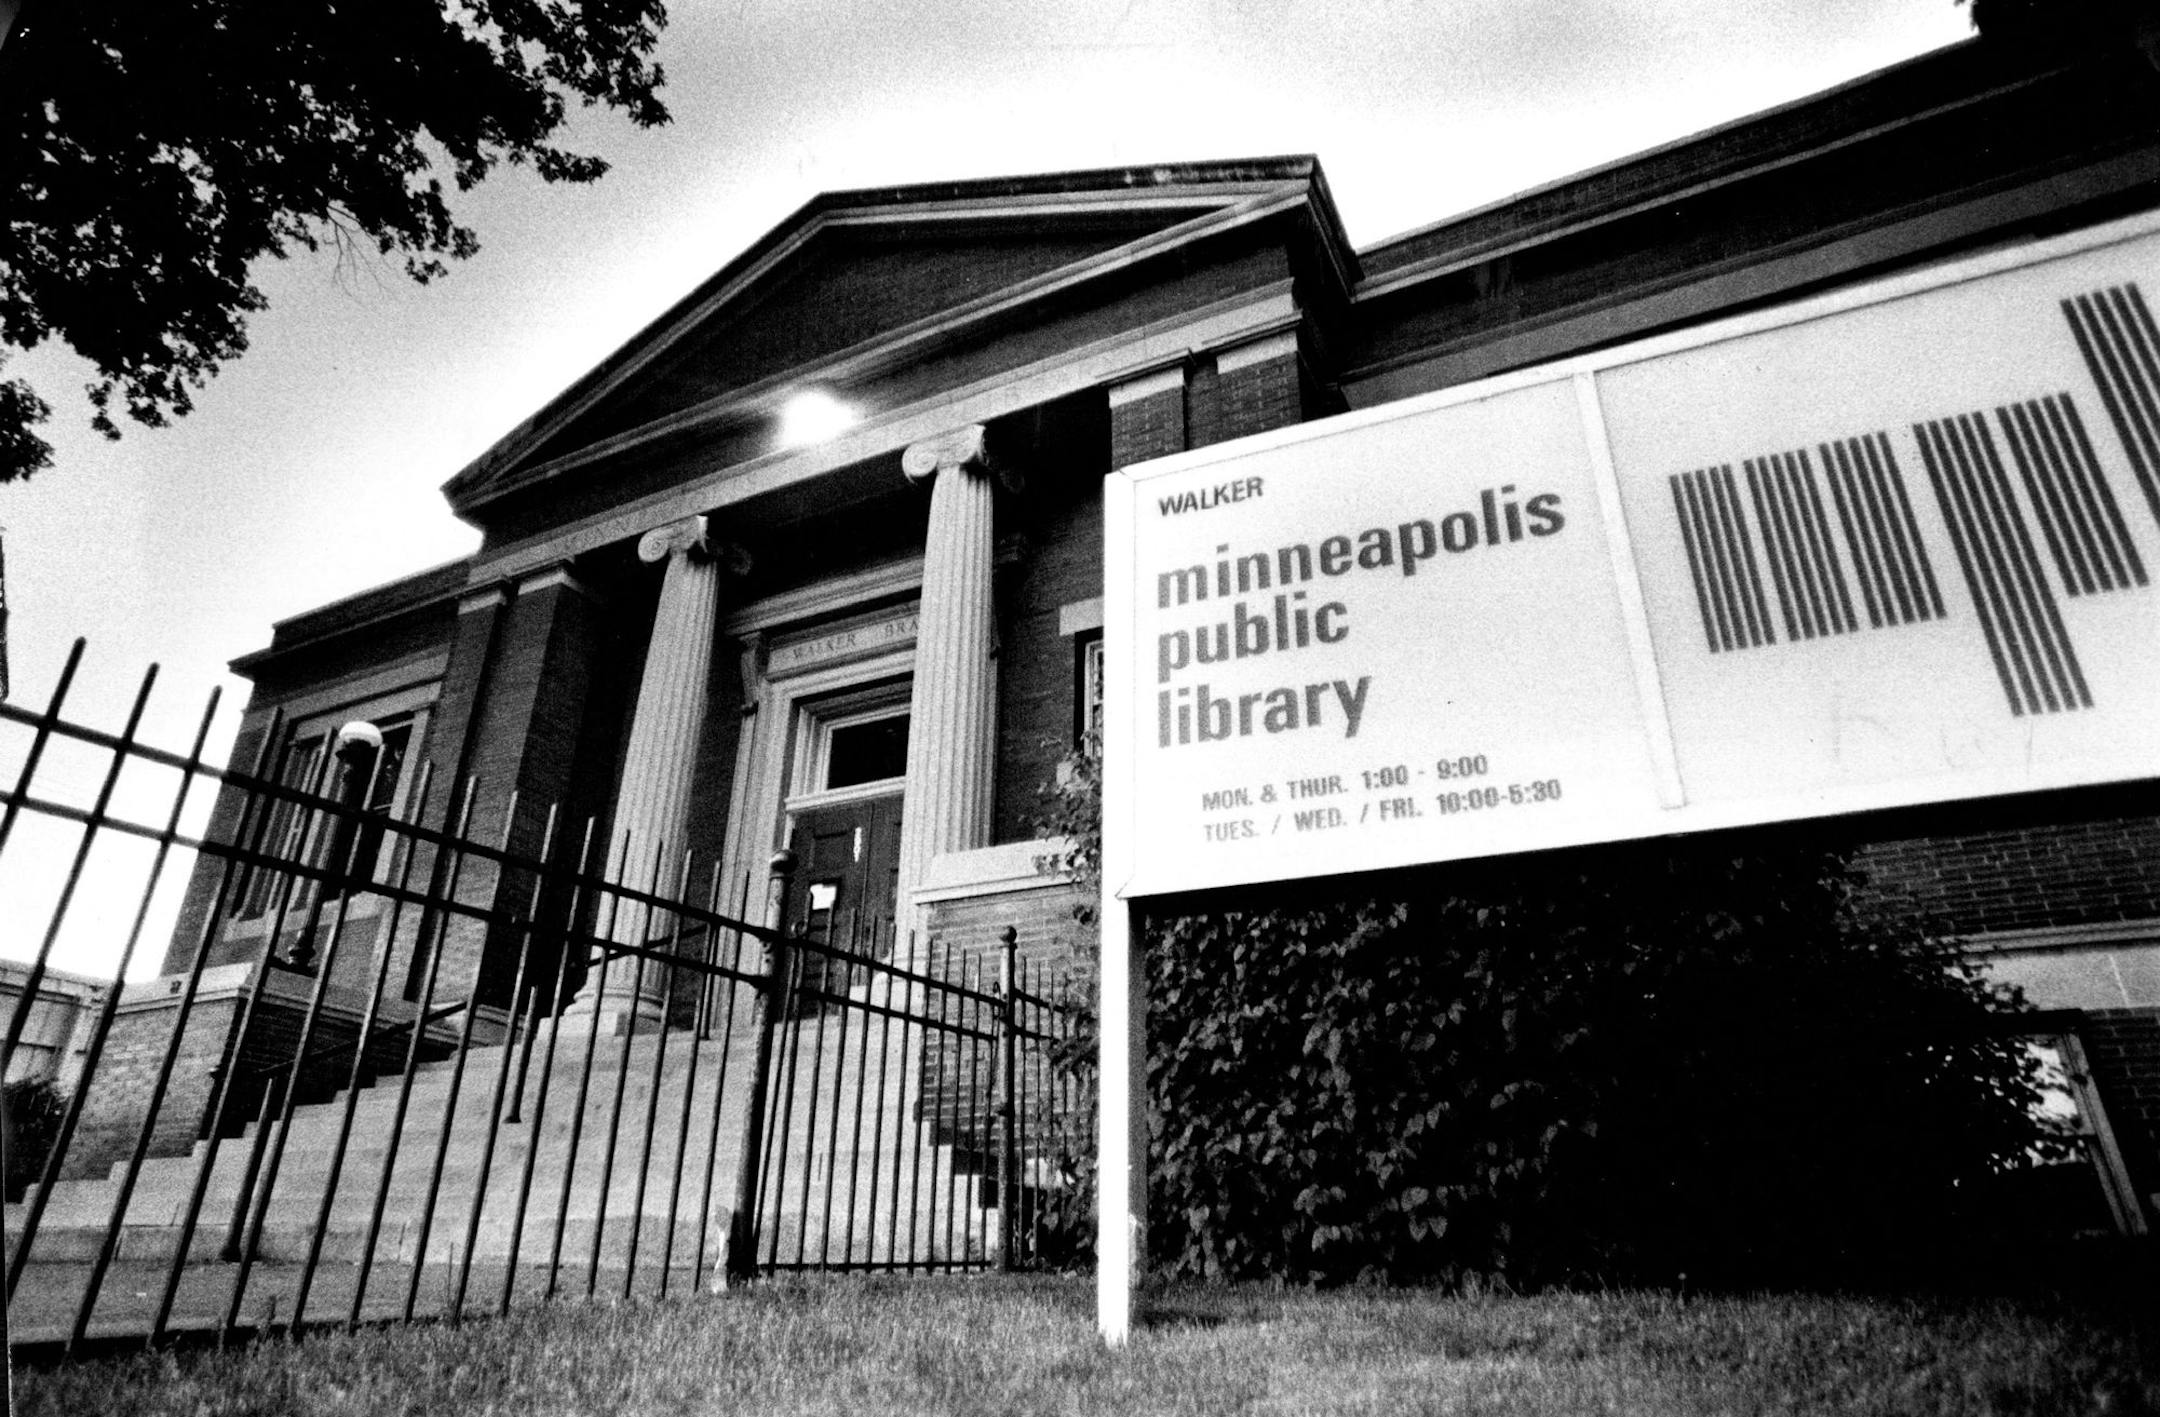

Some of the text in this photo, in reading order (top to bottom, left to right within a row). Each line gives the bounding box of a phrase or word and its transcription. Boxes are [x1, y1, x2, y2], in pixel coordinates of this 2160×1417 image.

[1158, 476, 1264, 517] WALKER
[1158, 484, 1566, 609] minneapolis
[1158, 590, 1350, 684] public
[1158, 675, 1372, 748] library
[1201, 786, 1254, 811] MON.
[1258, 783, 1278, 804] &
[1286, 773, 1349, 800] THUR.
[1361, 764, 1410, 790] 1:00
[1436, 754, 1489, 780] 9:00
[1203, 818, 1260, 842] TUES.
[1293, 807, 1347, 832] WED.
[1379, 797, 1423, 822] FRI.
[1436, 778, 1563, 816] 10:00-5:30
